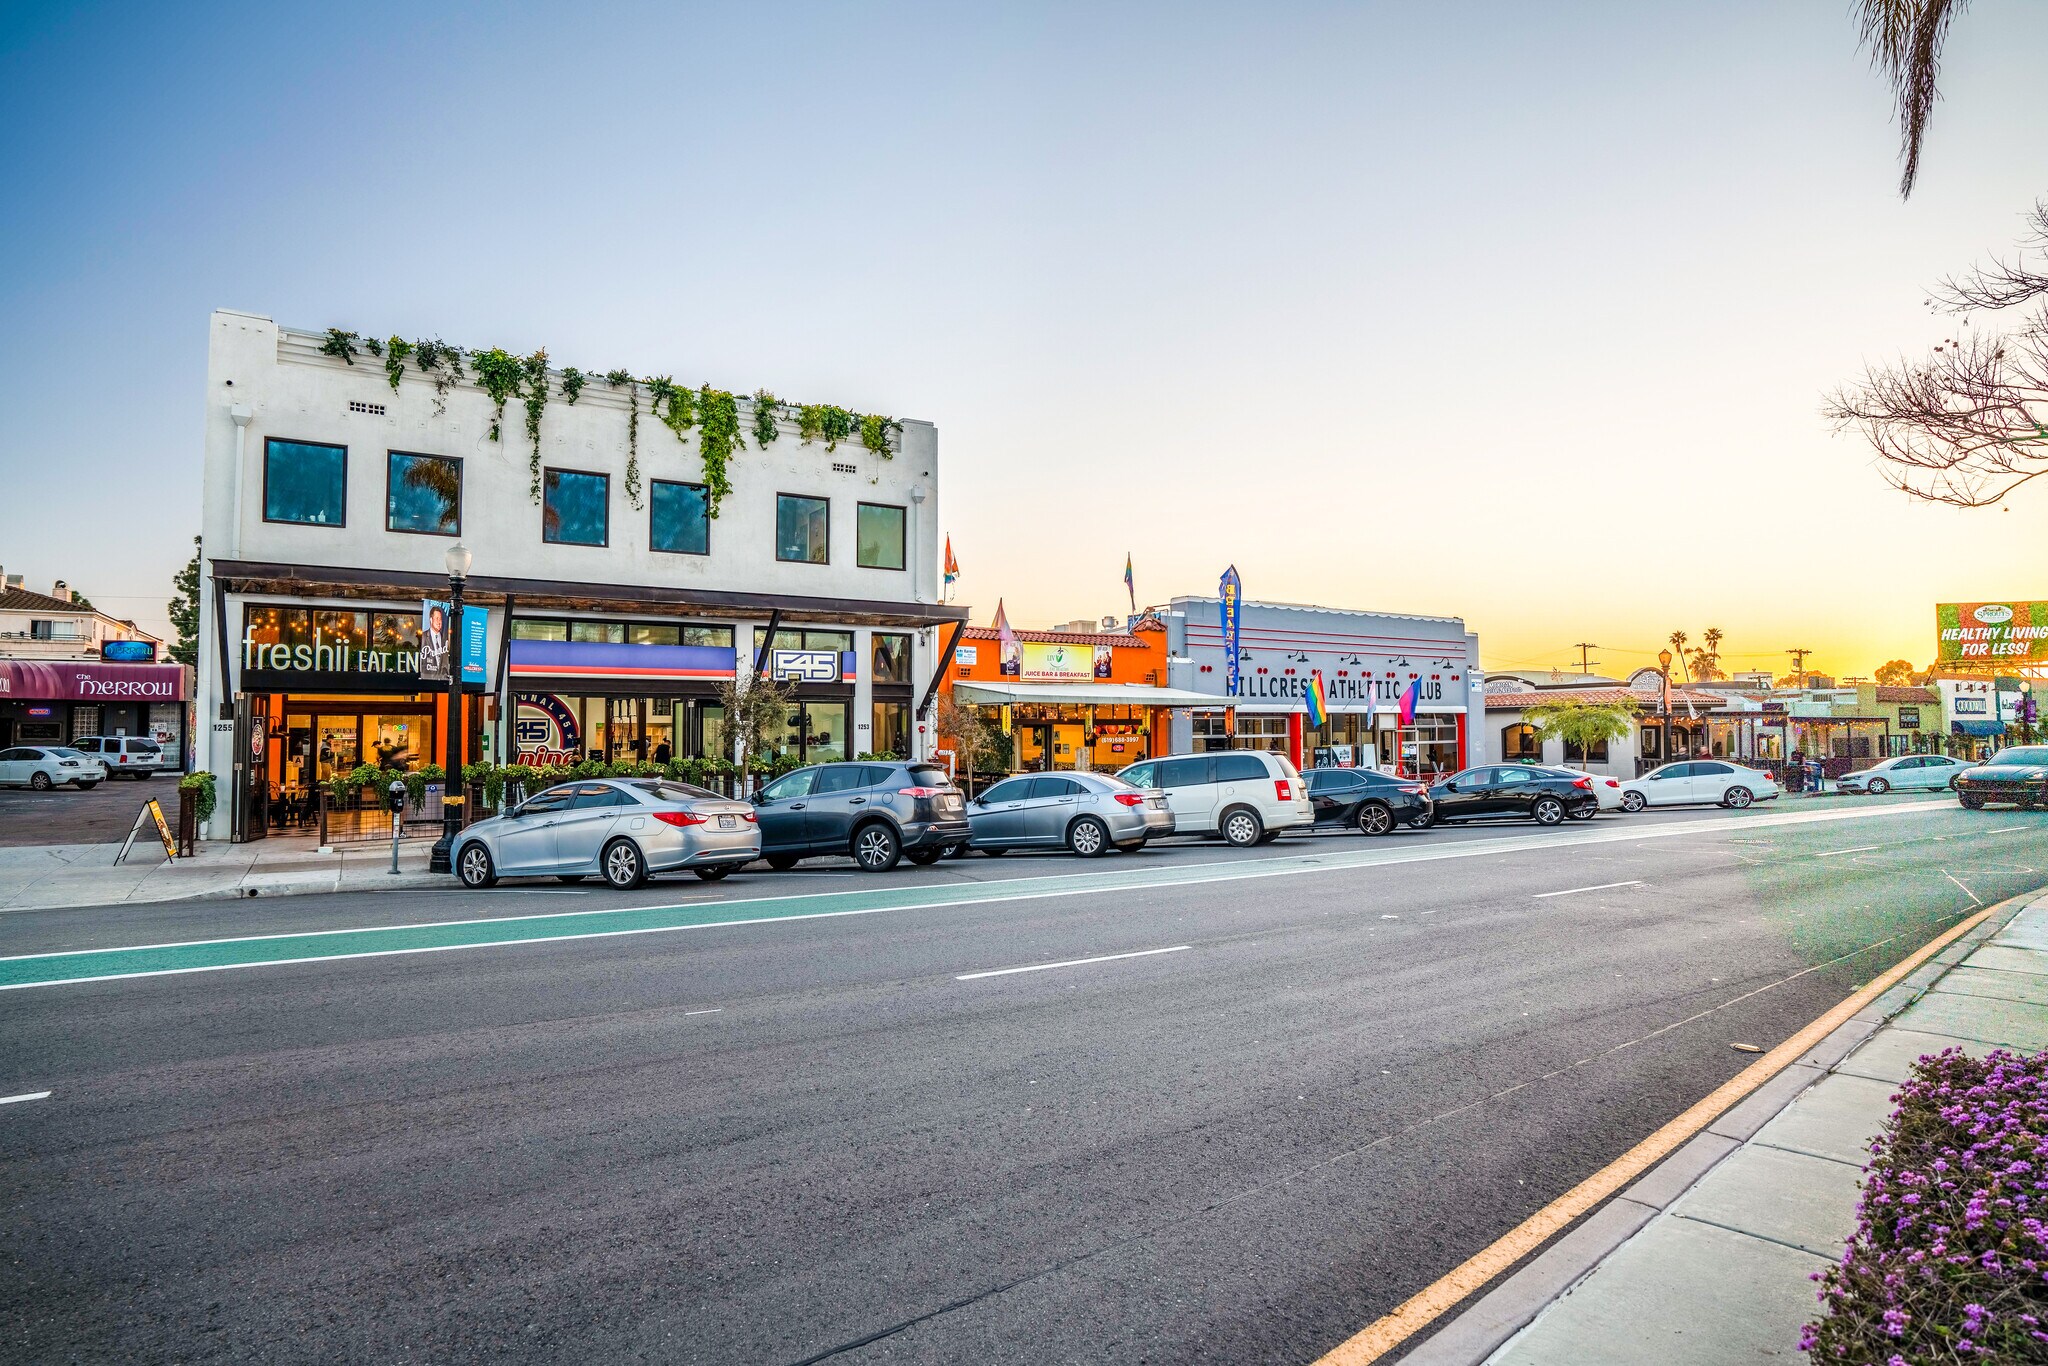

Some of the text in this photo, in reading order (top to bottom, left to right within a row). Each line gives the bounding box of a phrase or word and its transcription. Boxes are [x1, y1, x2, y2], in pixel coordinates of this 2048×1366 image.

[1976, 610, 2011, 619] SPROUTS
[1941, 626, 2048, 640] HEALTHY LIVING
[242, 625, 350, 672] freshii
[358, 650, 394, 673] EAT.
[1961, 641, 2031, 656] FOR LESS!
[775, 651, 836, 681] F45
[1226, 676, 1315, 698] HILLCRES
[1410, 681, 1442, 700] LUB
[213, 723, 233, 732] 1255
[294, 756, 302, 764] A
